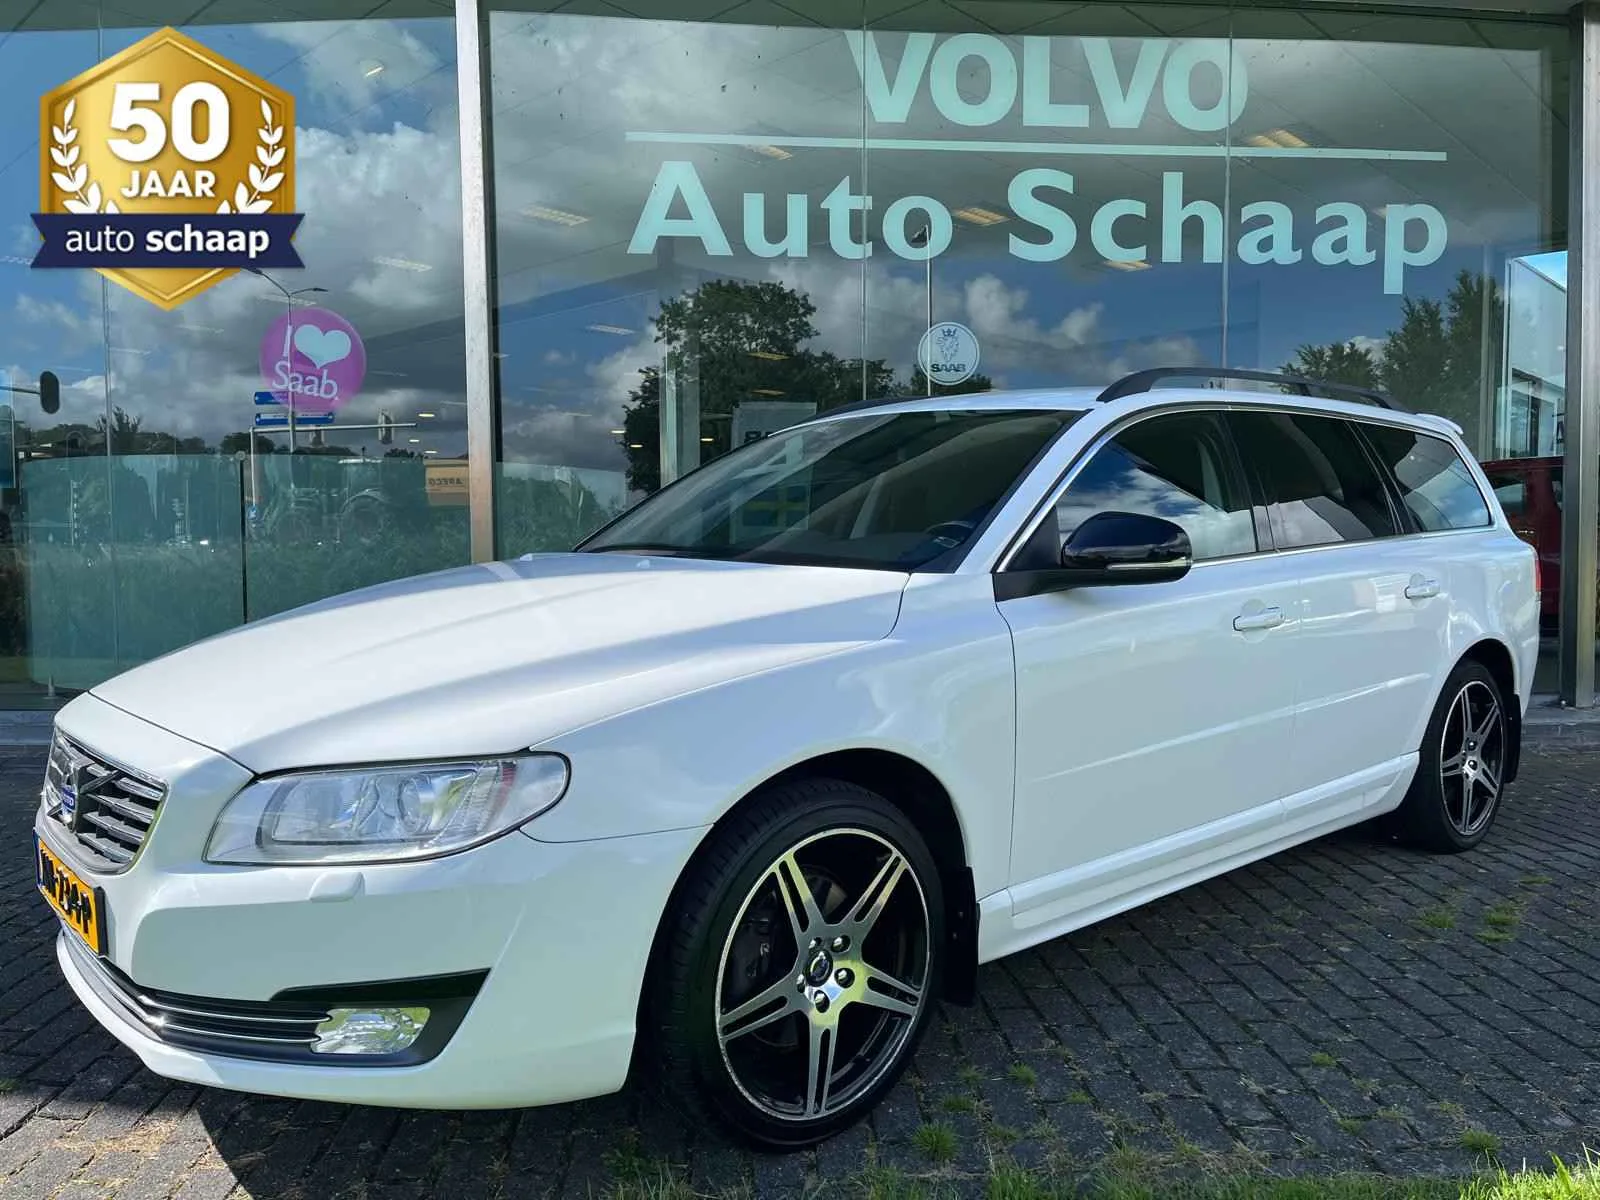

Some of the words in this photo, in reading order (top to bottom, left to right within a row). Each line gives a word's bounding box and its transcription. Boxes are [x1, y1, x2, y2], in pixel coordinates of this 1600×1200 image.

[843, 30, 1249, 132] VOLVO
[626, 160, 954, 261] Auto
[1006, 167, 1449, 295] Schaap
[282, 324, 294, 358] I
[930, 363, 967, 373] SAAB
